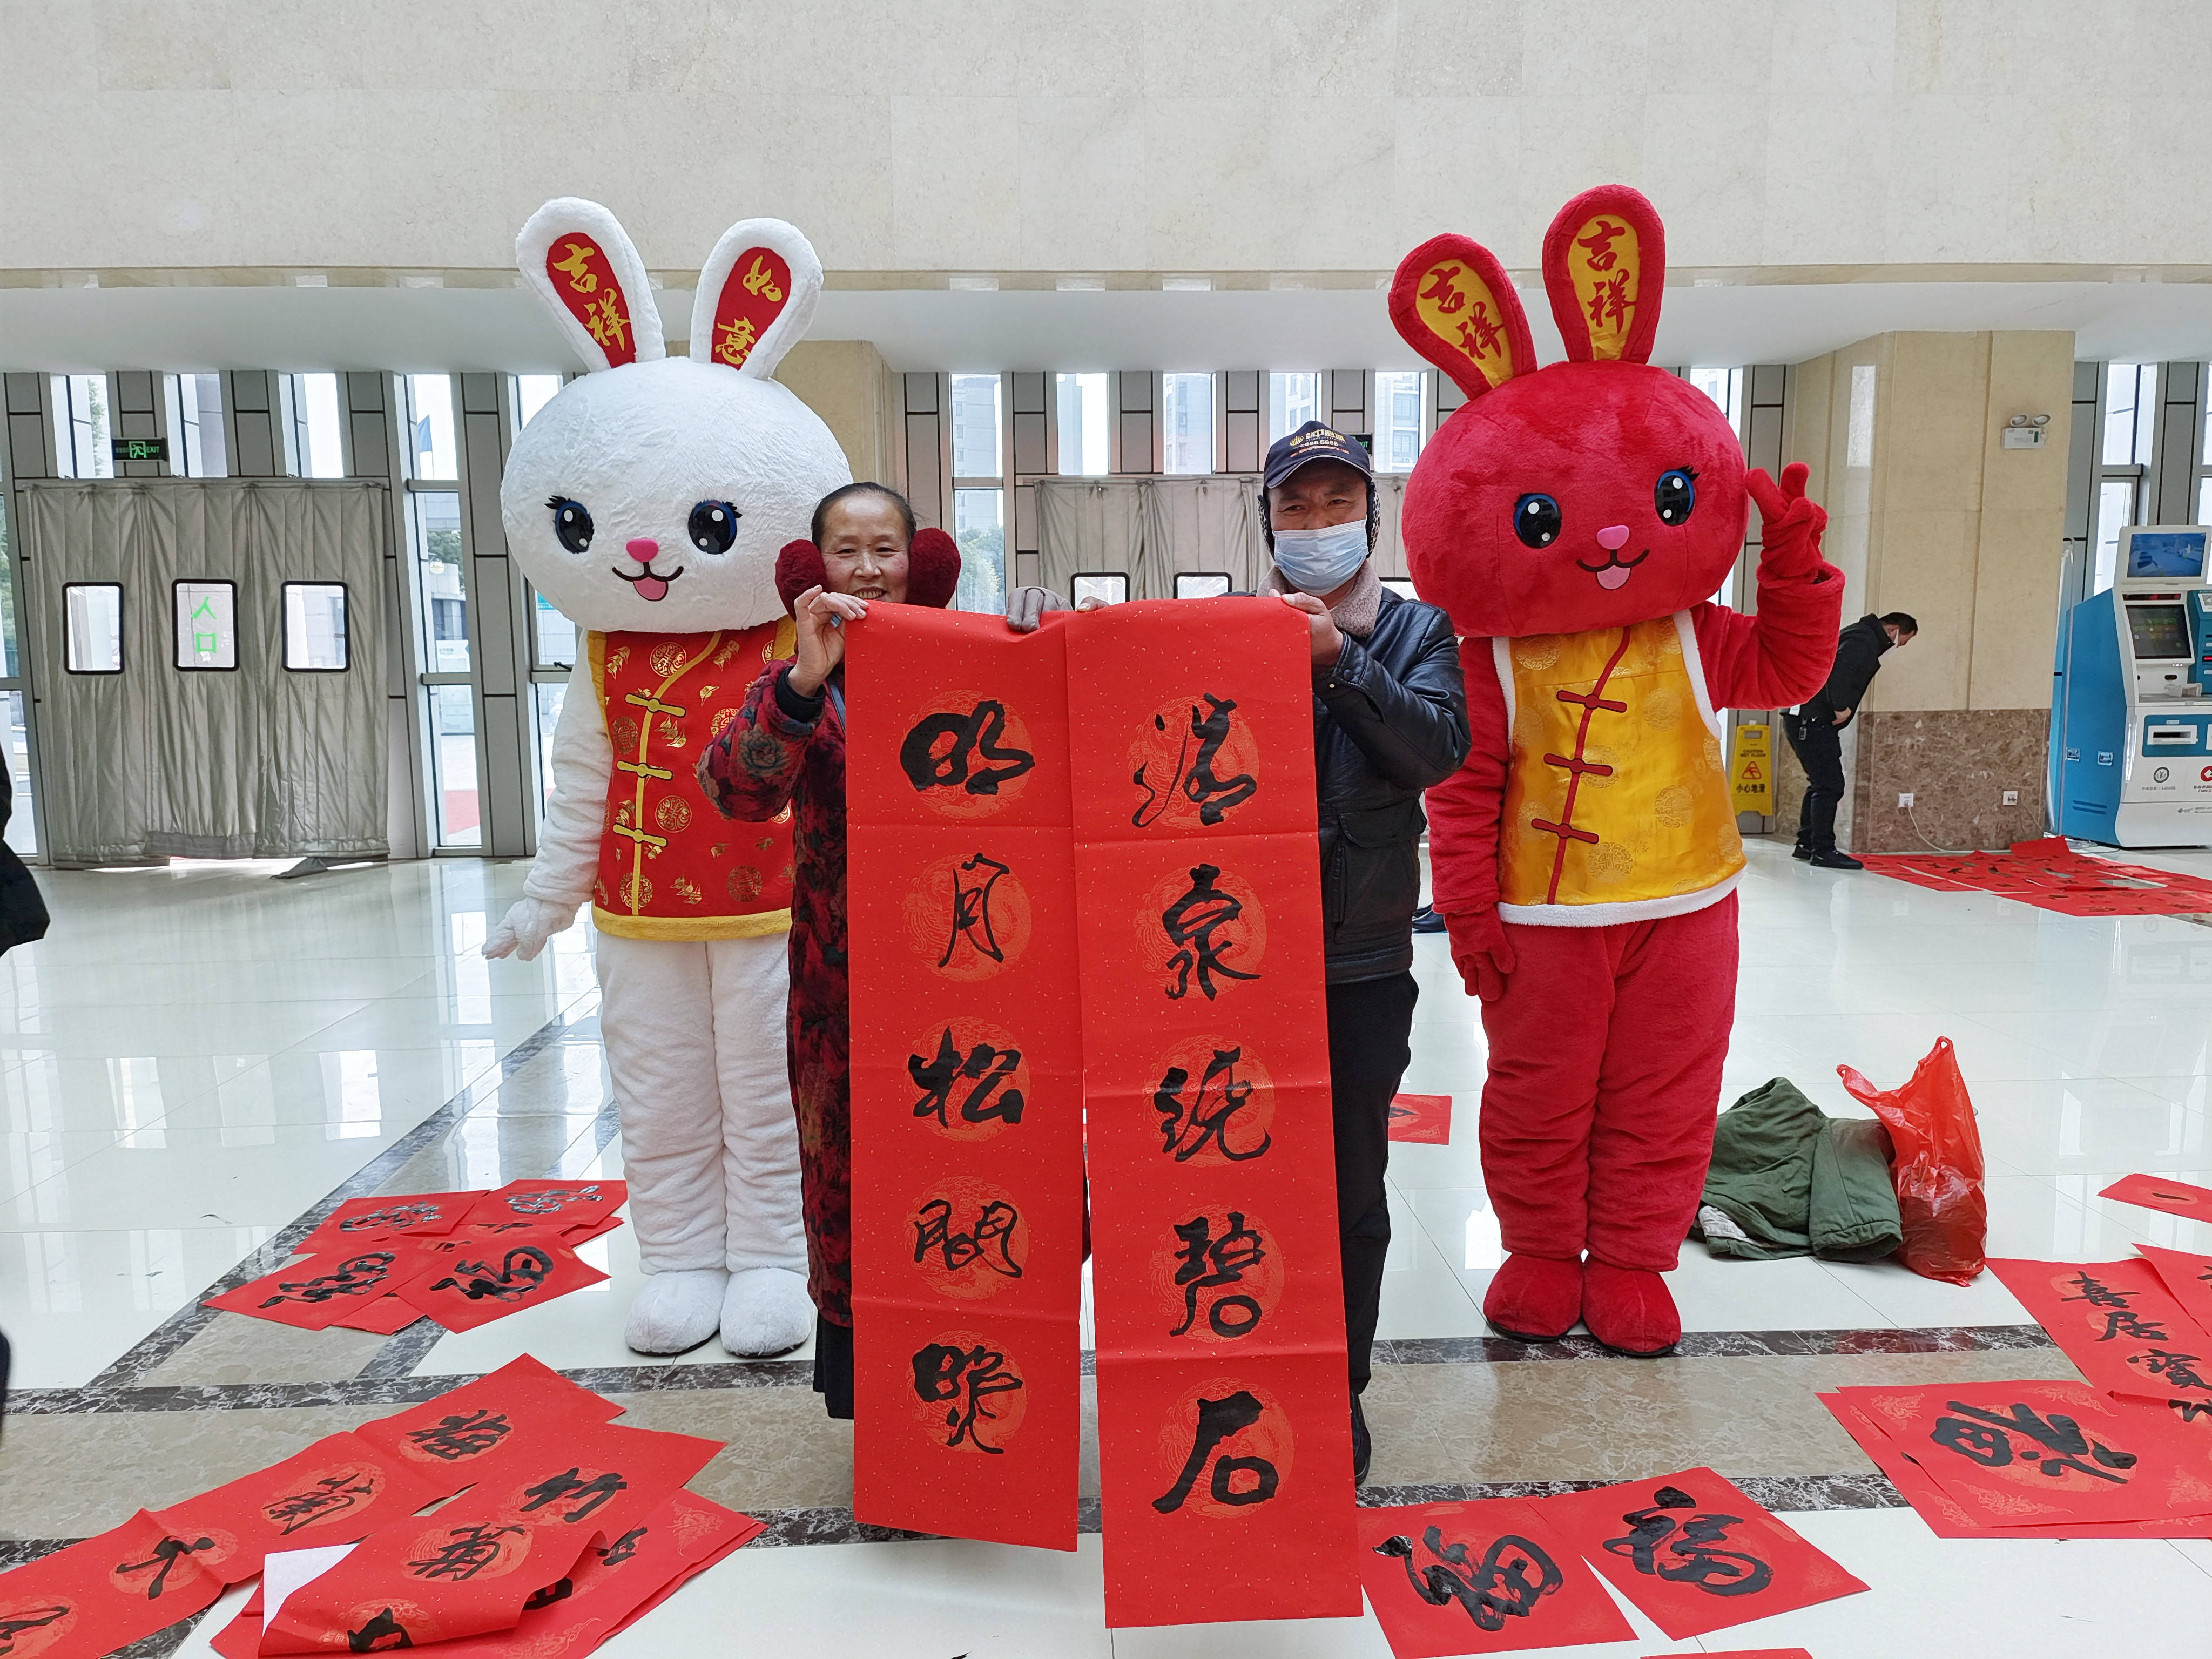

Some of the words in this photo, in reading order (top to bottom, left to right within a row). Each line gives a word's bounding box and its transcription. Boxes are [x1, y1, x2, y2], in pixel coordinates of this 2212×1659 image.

[553, 243, 630, 351] 吉祥
[714, 255, 783, 365] 如意
[1420, 266, 1505, 360] 吉祥
[1577, 220, 1637, 334] 吉祥
[1736, 783, 1766, 793] 小心地滑
